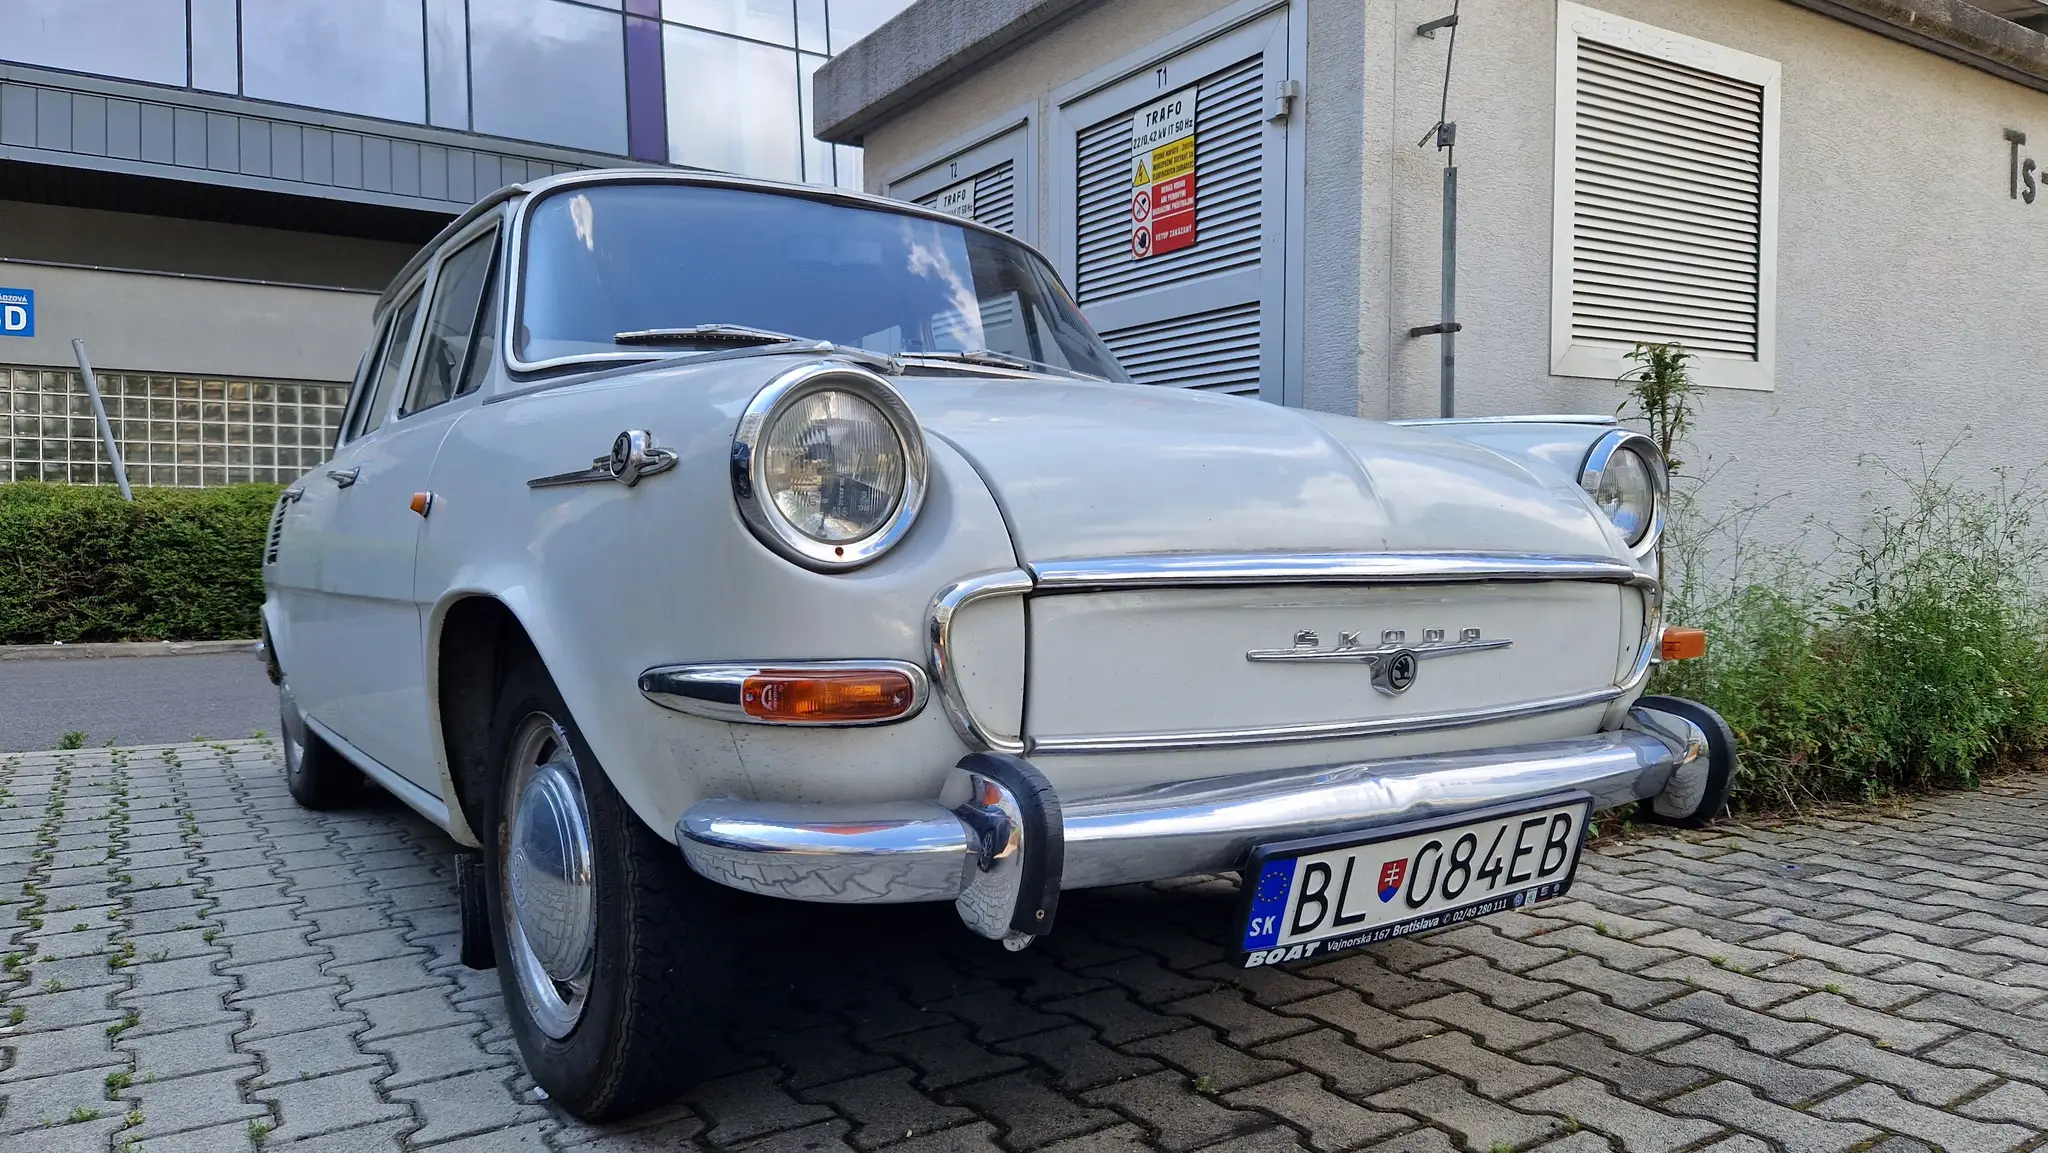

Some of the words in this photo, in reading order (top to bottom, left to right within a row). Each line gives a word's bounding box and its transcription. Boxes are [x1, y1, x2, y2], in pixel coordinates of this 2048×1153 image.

[1156, 66, 1167, 89] T1
[1146, 101, 1182, 128] TRAFO
[1158, 127, 1167, 140] kV
[1168, 124, 1174, 136] IT
[1175, 120, 1184, 133] 50
[1185, 117, 1193, 129] Hz
[950, 162, 957, 179] T2
[944, 189, 966, 207] TRAFO
[1155, 231, 1169, 242] VSTUP
[1289, 856, 1366, 937] BL
[1405, 812, 1573, 910] 084EB
[1244, 941, 1321, 968] BOAT
[1327, 932, 1371, 951] Vajnorská
[1373, 928, 1391, 942] 167
[1392, 916, 1440, 937] Bratislava
[1452, 906, 1477, 922] 02/49
[1477, 902, 1492, 916] 280
[1493, 899, 1507, 912] 111
[1249, 915, 1276, 937] SK
